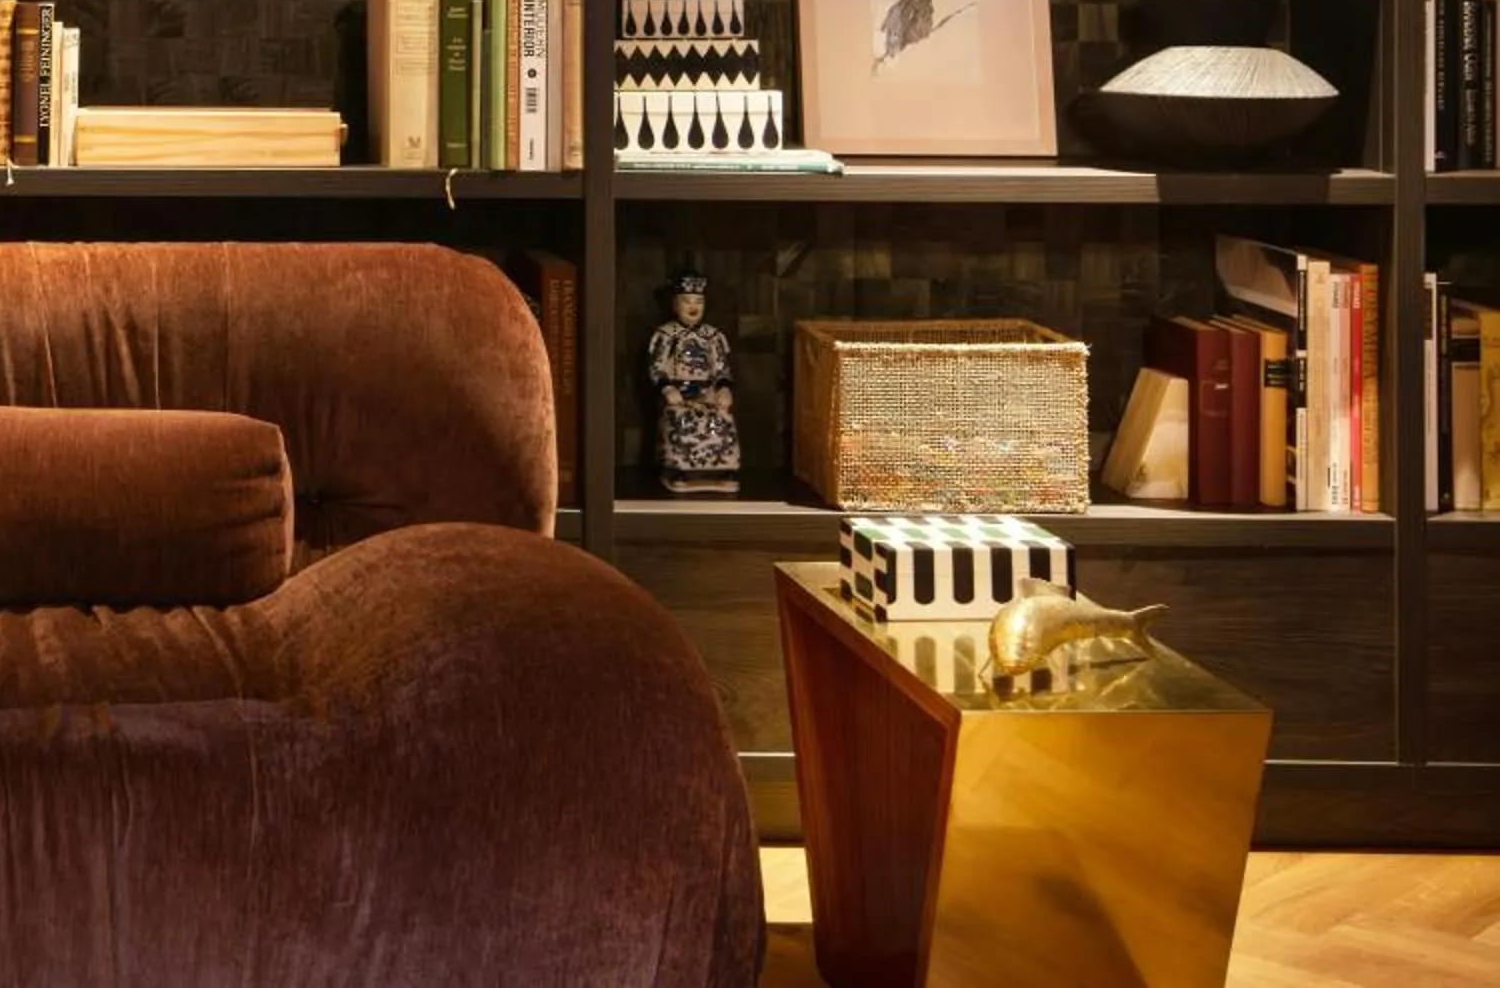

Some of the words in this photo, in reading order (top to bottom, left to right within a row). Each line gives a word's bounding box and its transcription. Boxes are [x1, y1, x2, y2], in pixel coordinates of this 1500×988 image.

[40, 7, 53, 77] FEININGER
[524, 0, 535, 58] INTERIOR
[39, 82, 50, 128] LYONEL
